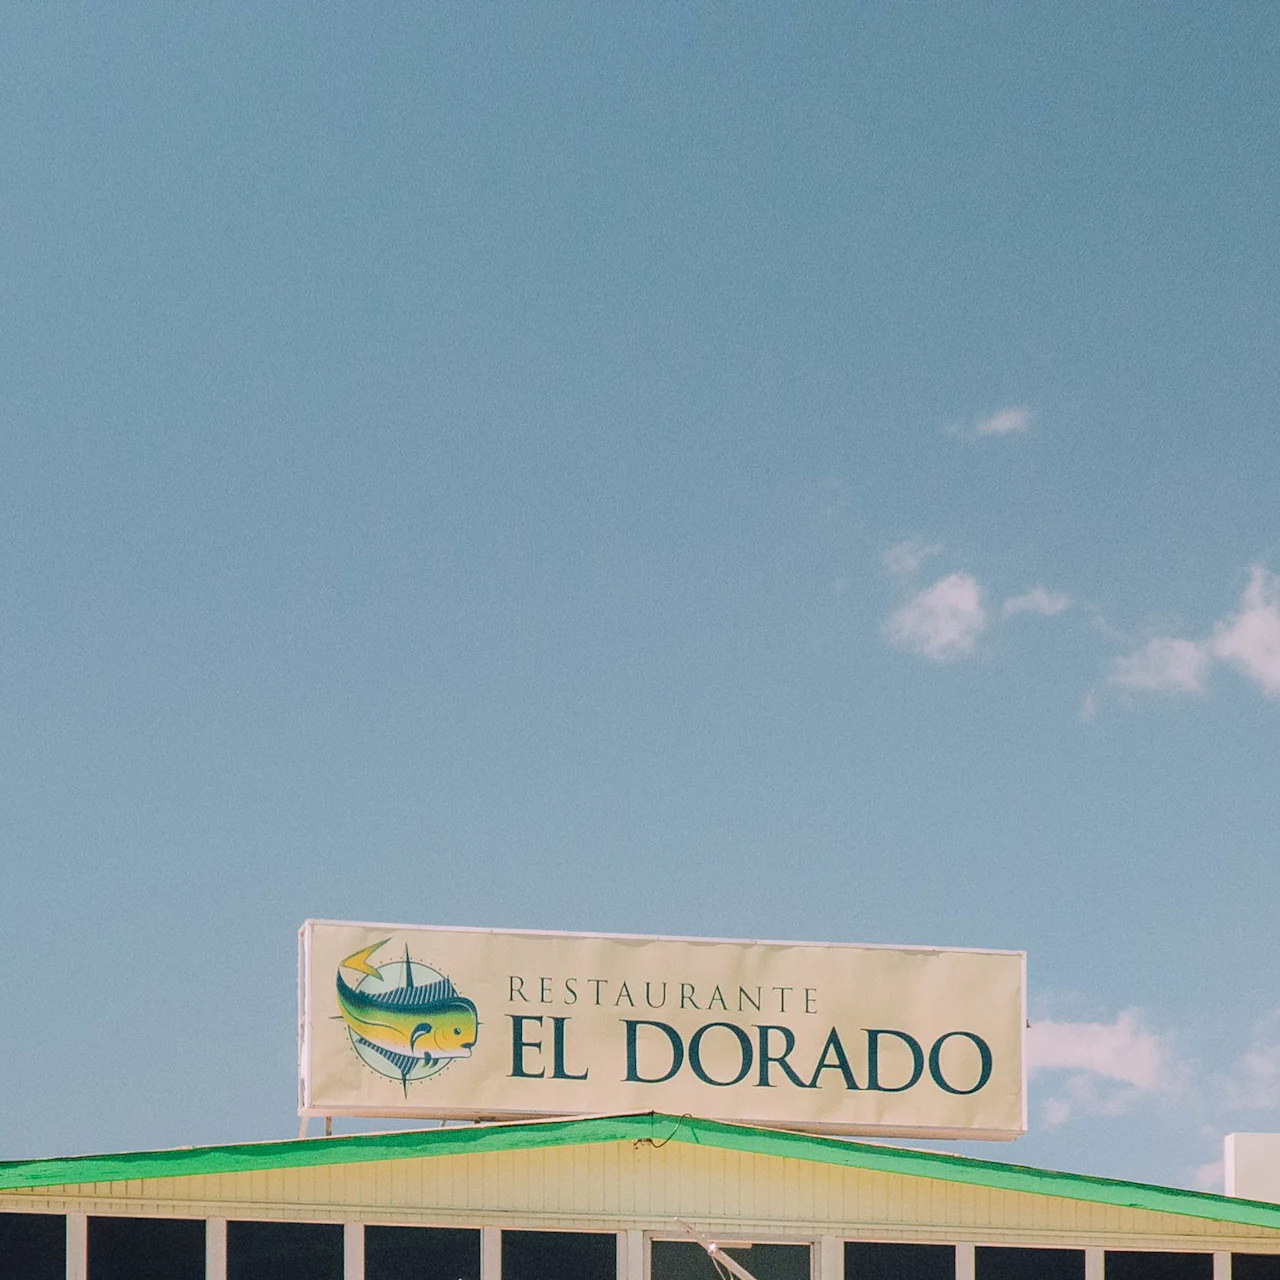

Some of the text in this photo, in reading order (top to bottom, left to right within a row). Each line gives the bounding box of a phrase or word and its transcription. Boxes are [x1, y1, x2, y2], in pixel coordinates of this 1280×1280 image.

[507, 975, 818, 1014] RESTAURANTE
[504, 1014, 993, 1096] EL DORADO
